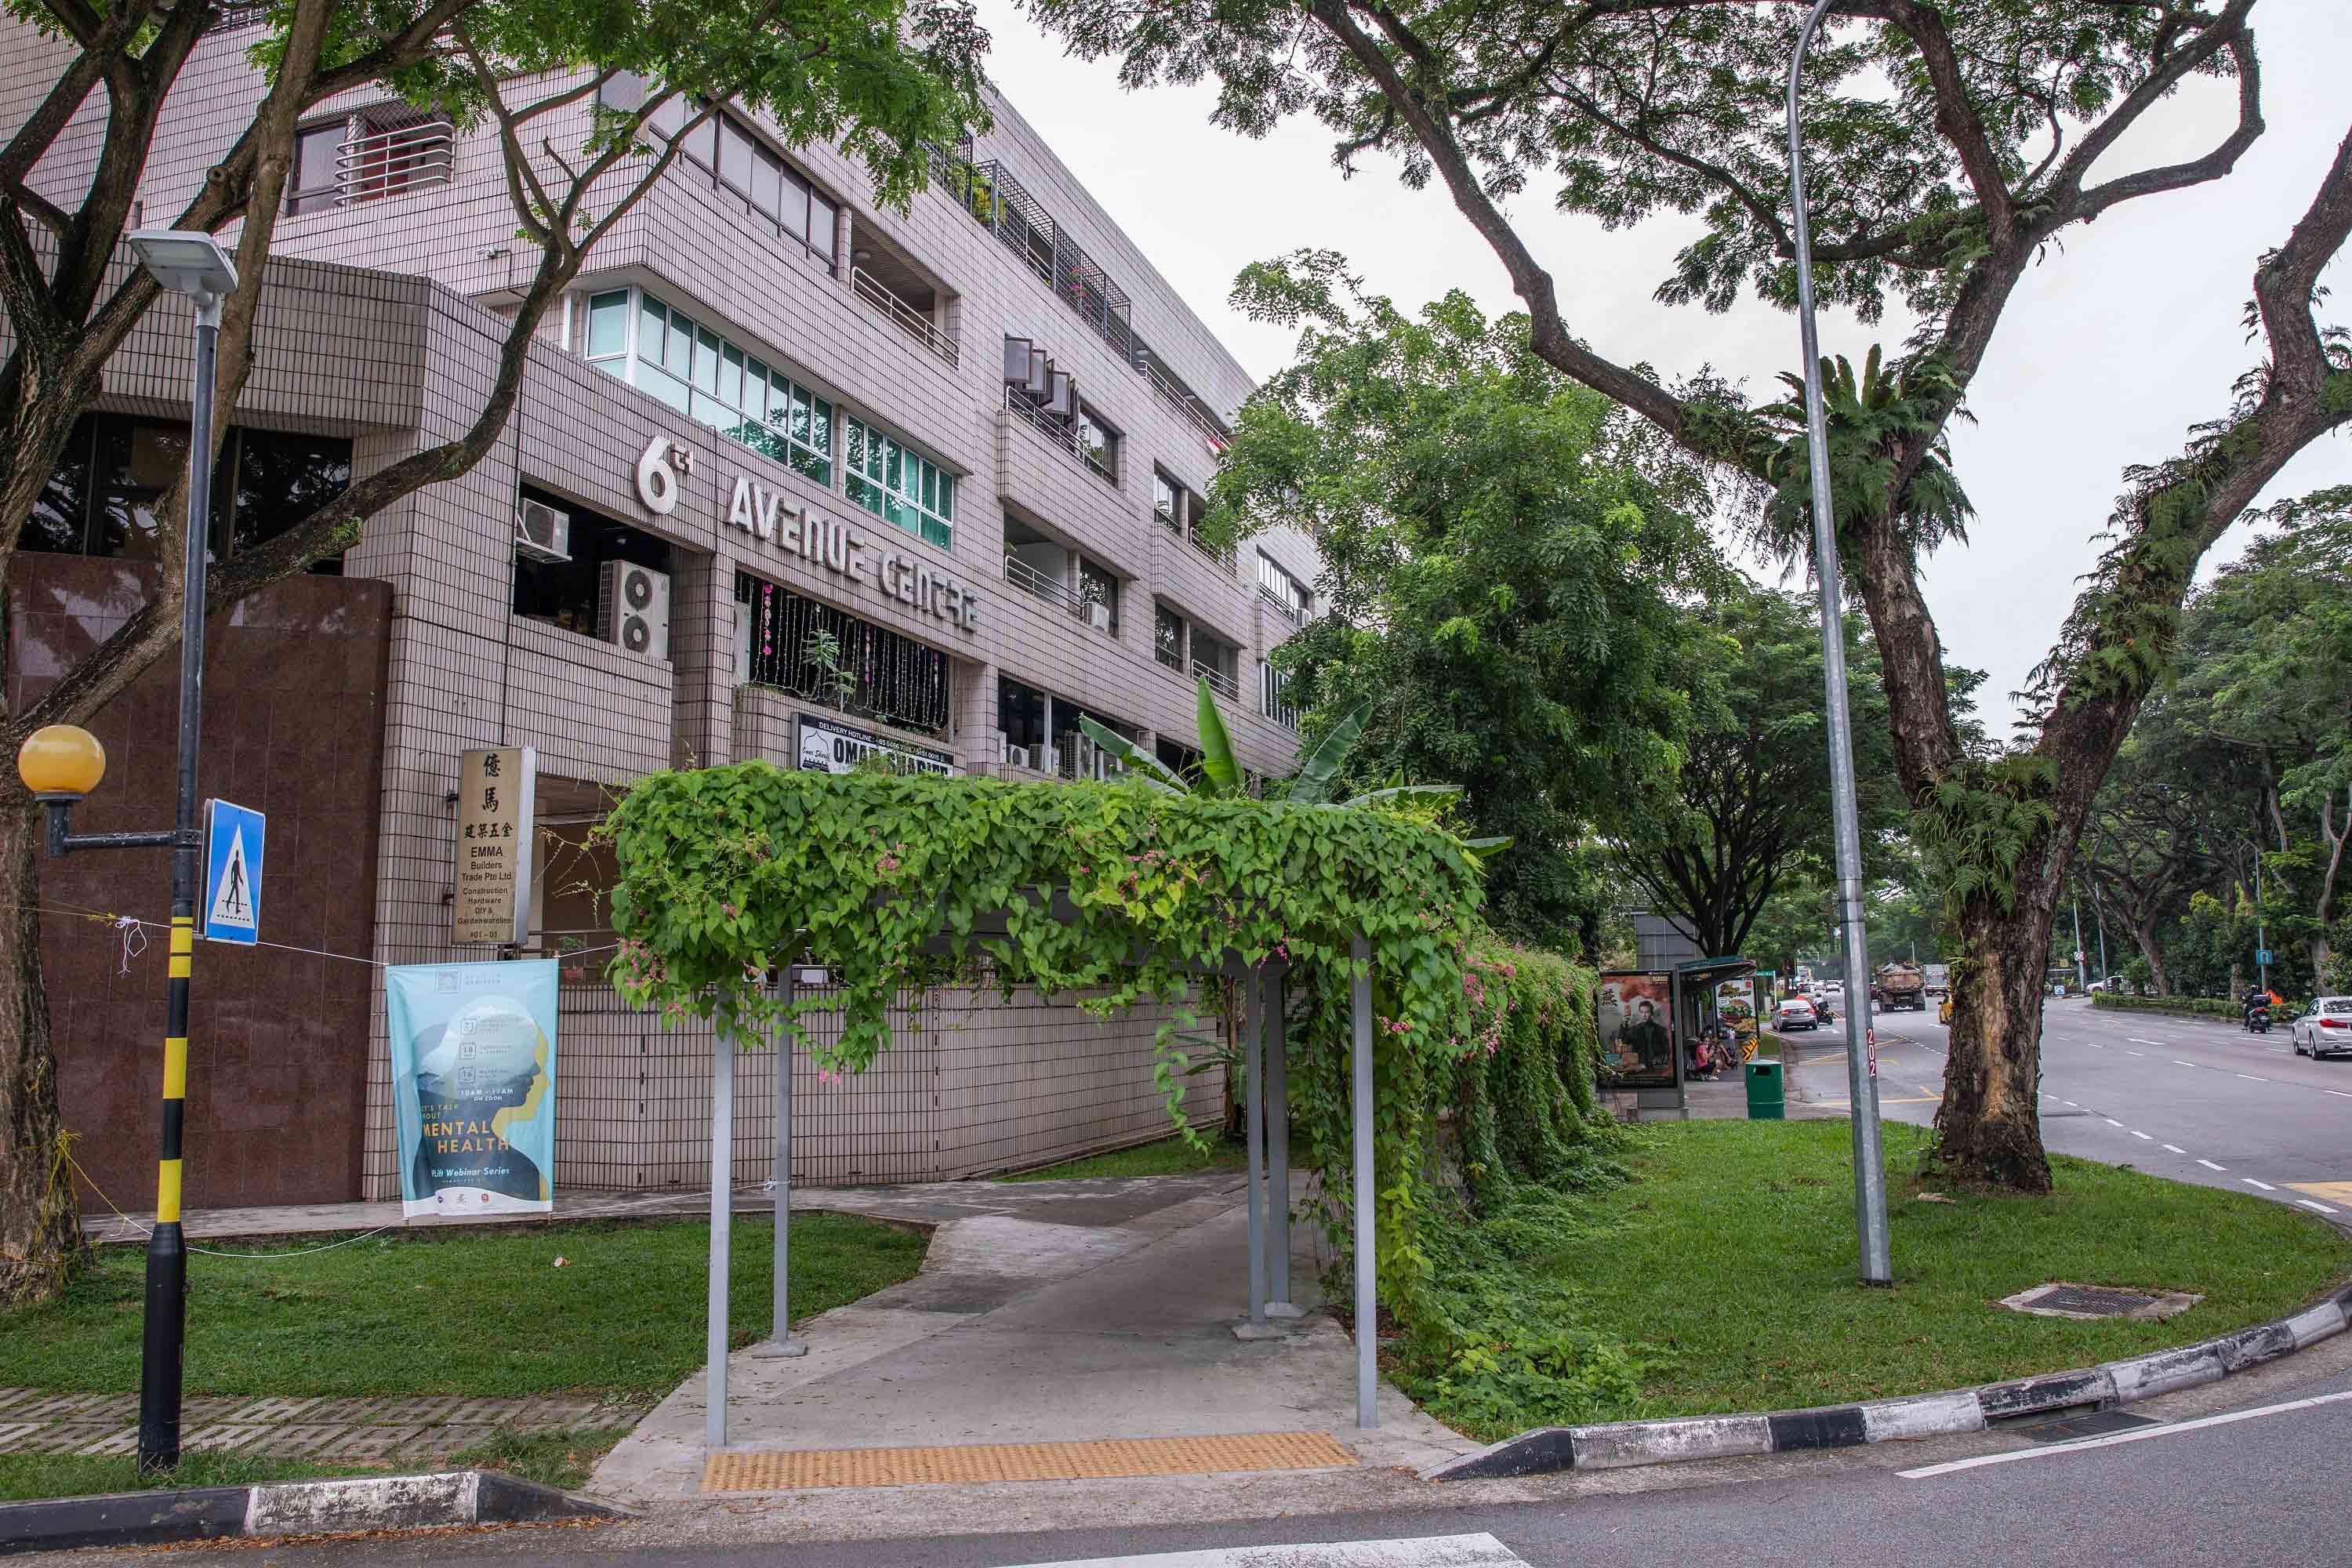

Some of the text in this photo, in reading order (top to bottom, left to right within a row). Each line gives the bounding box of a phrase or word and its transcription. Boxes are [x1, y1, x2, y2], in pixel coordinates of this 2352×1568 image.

[724, 474, 866, 583] AVENUE
[878, 551, 978, 633] CENTRE
[818, 721, 848, 735] DELIVERY
[470, 846, 503, 858] EMMA
[470, 861, 503, 870] Builders
[462, 871, 512, 881] Trade Pte Ltd
[1867, 1028, 1876, 1076] 202
[423, 1120, 490, 1137] MENTAL
[437, 1137, 509, 1154] HEALTH
[446, 1167, 482, 1177] Webinar
[484, 1166, 510, 1175] Series
